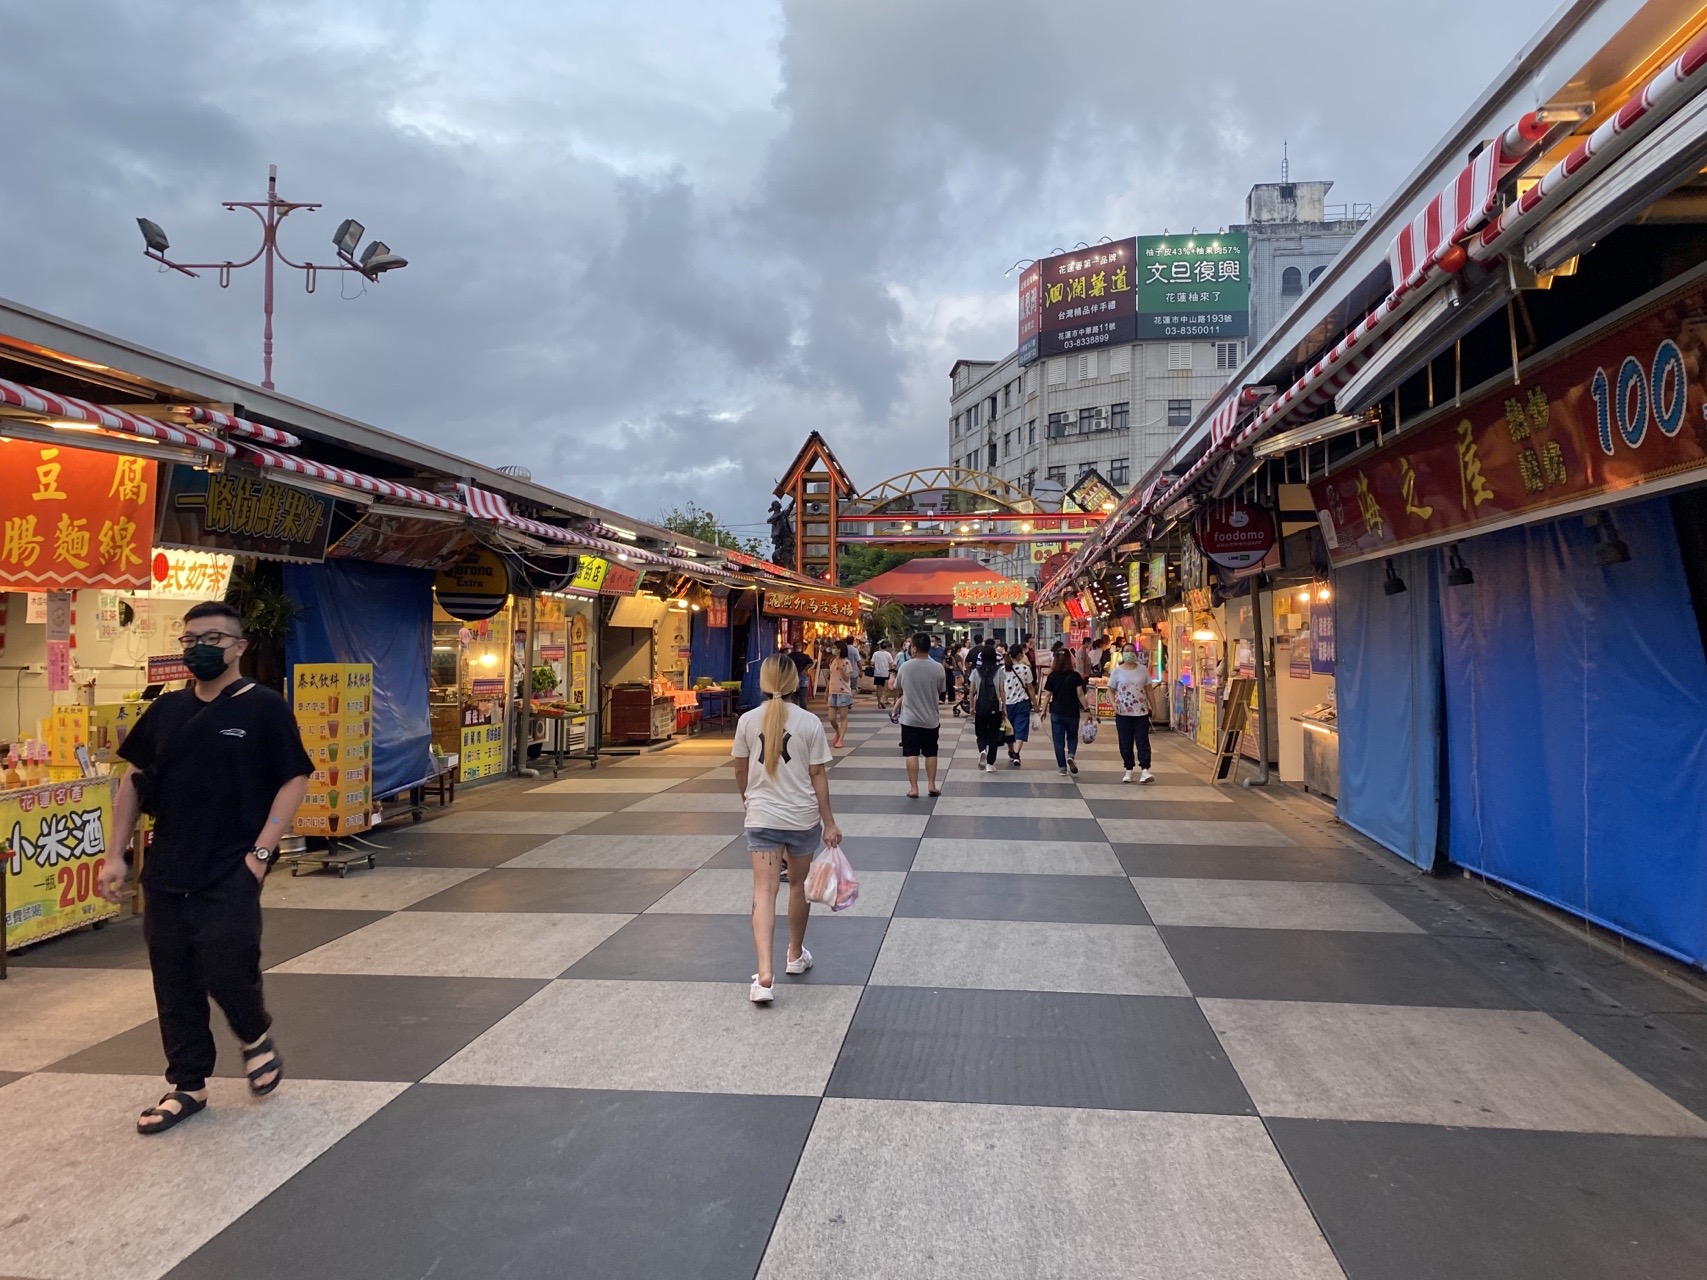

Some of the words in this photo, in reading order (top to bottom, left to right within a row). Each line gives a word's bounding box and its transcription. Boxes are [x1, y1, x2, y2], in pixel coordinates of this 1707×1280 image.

[1145, 260, 1241, 284] 文旦復興
[1165, 291, 1221, 303] 花蓮柚來了
[1058, 300, 1117, 321] 台灣精品伴手禮
[1153, 314, 1233, 325] 花蓮市中山路193號
[1057, 322, 1116, 341] 花蓮市中華路11號
[1165, 325, 1220, 336] 03-8350011
[1063, 333, 1110, 349] 03-8338899
[1590, 338, 1688, 456] 100
[31, 448, 148, 505] 豆腐
[176, 472, 324, 544] 一條街鮮果汁
[1, 512, 143, 572] 腸麵線
[1214, 530, 1265, 541] foodomo
[156, 559, 229, 592] 式奶茶
[443, 563, 493, 578] Corona
[456, 577, 484, 588] Extra
[100, 609, 117, 622] 紅茶
[967, 604, 993, 613] 出口
[297, 672, 340, 689] 泰式飲料
[346, 672, 371, 688] 泰式飲料
[20, 785, 84, 811] 花蓮名產
[7, 807, 105, 874] 小米酒
